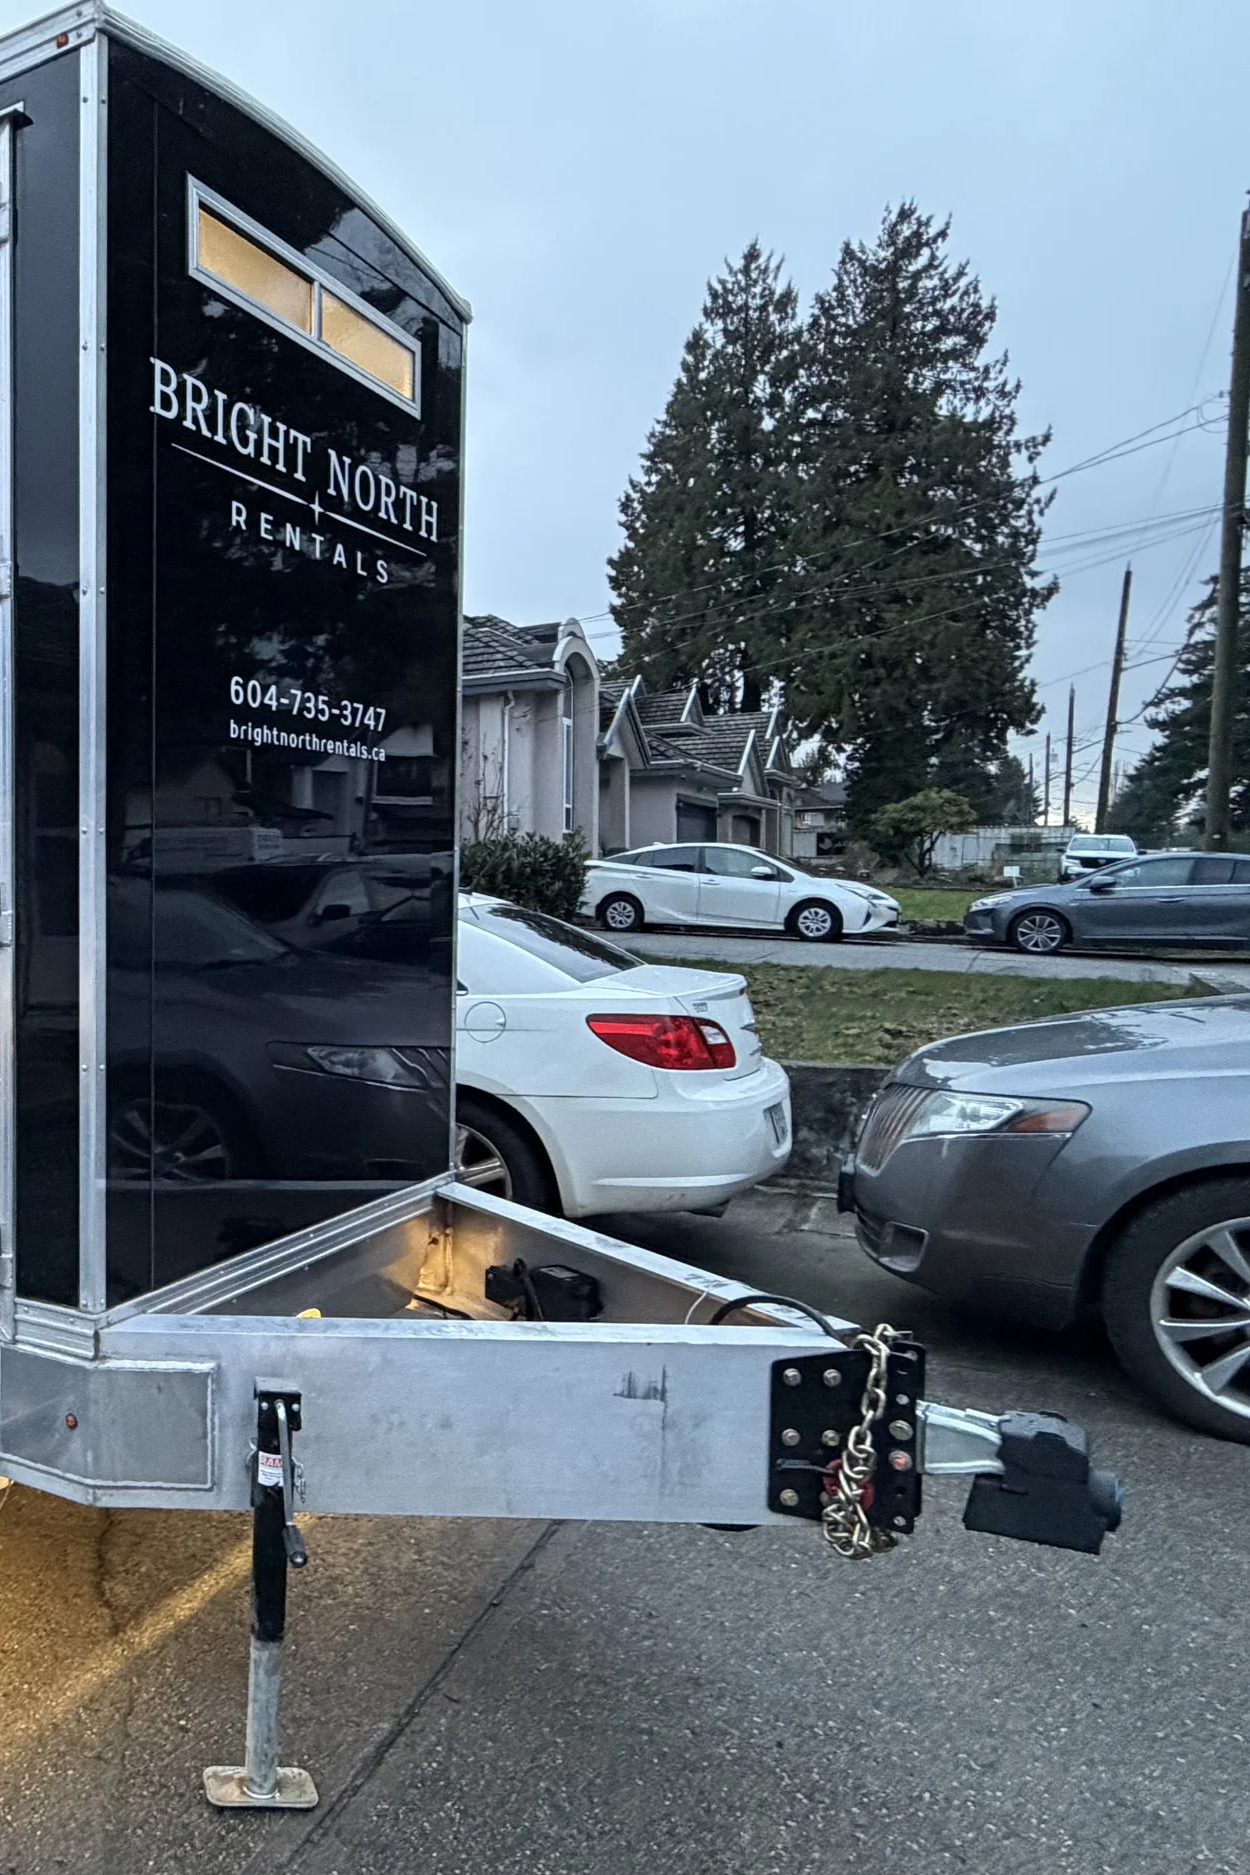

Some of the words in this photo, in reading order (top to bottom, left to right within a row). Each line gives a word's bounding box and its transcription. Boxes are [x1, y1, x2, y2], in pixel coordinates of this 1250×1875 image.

[149, 357, 311, 481] BRIGHT
[327, 449, 438, 541] NORTH
[232, 501, 388, 583] RENTALS
[230, 676, 386, 731] 604-735-3747
[230, 719, 386, 761] brightnorthrentals.ca
